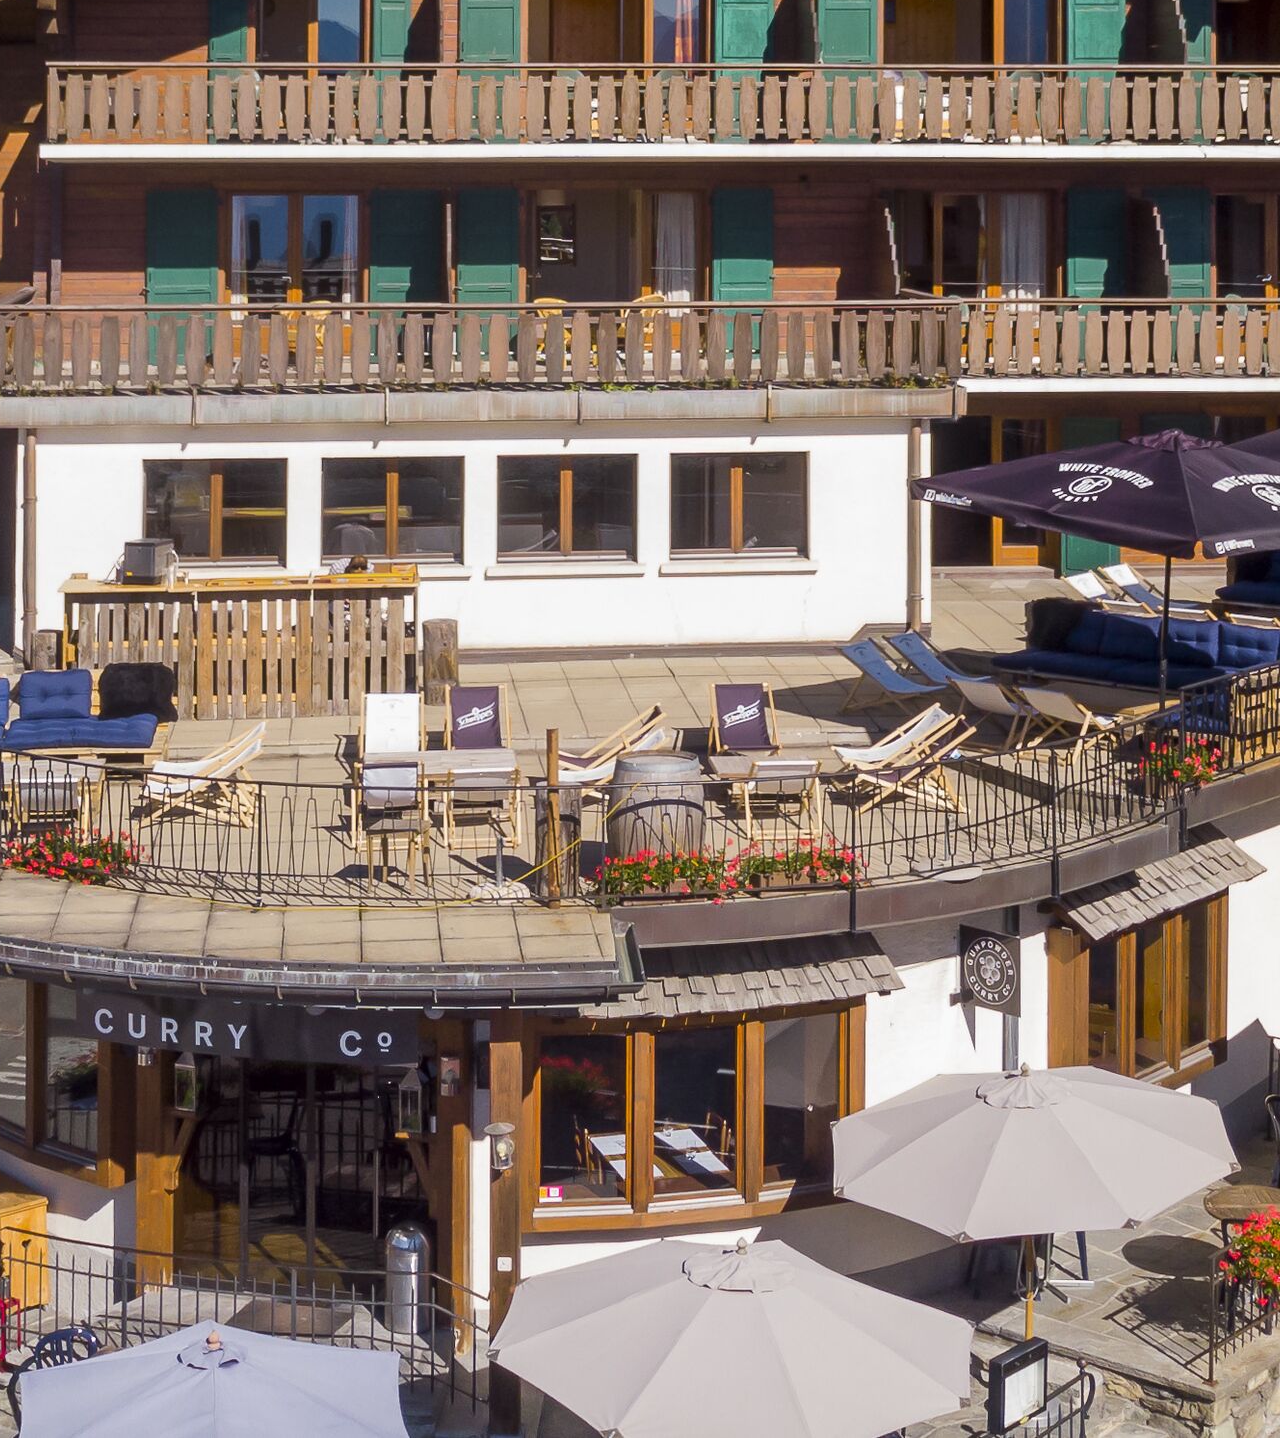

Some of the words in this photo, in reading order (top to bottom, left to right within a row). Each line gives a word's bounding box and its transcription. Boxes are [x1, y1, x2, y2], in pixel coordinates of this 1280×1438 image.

[1058, 462, 1103, 474] WHITE
[1100, 466, 1154, 489] FRONTIER
[967, 940, 1014, 977] GUNPOWDER
[969, 975, 1000, 1002] CURRY
[94, 1007, 249, 1051] CURRY
